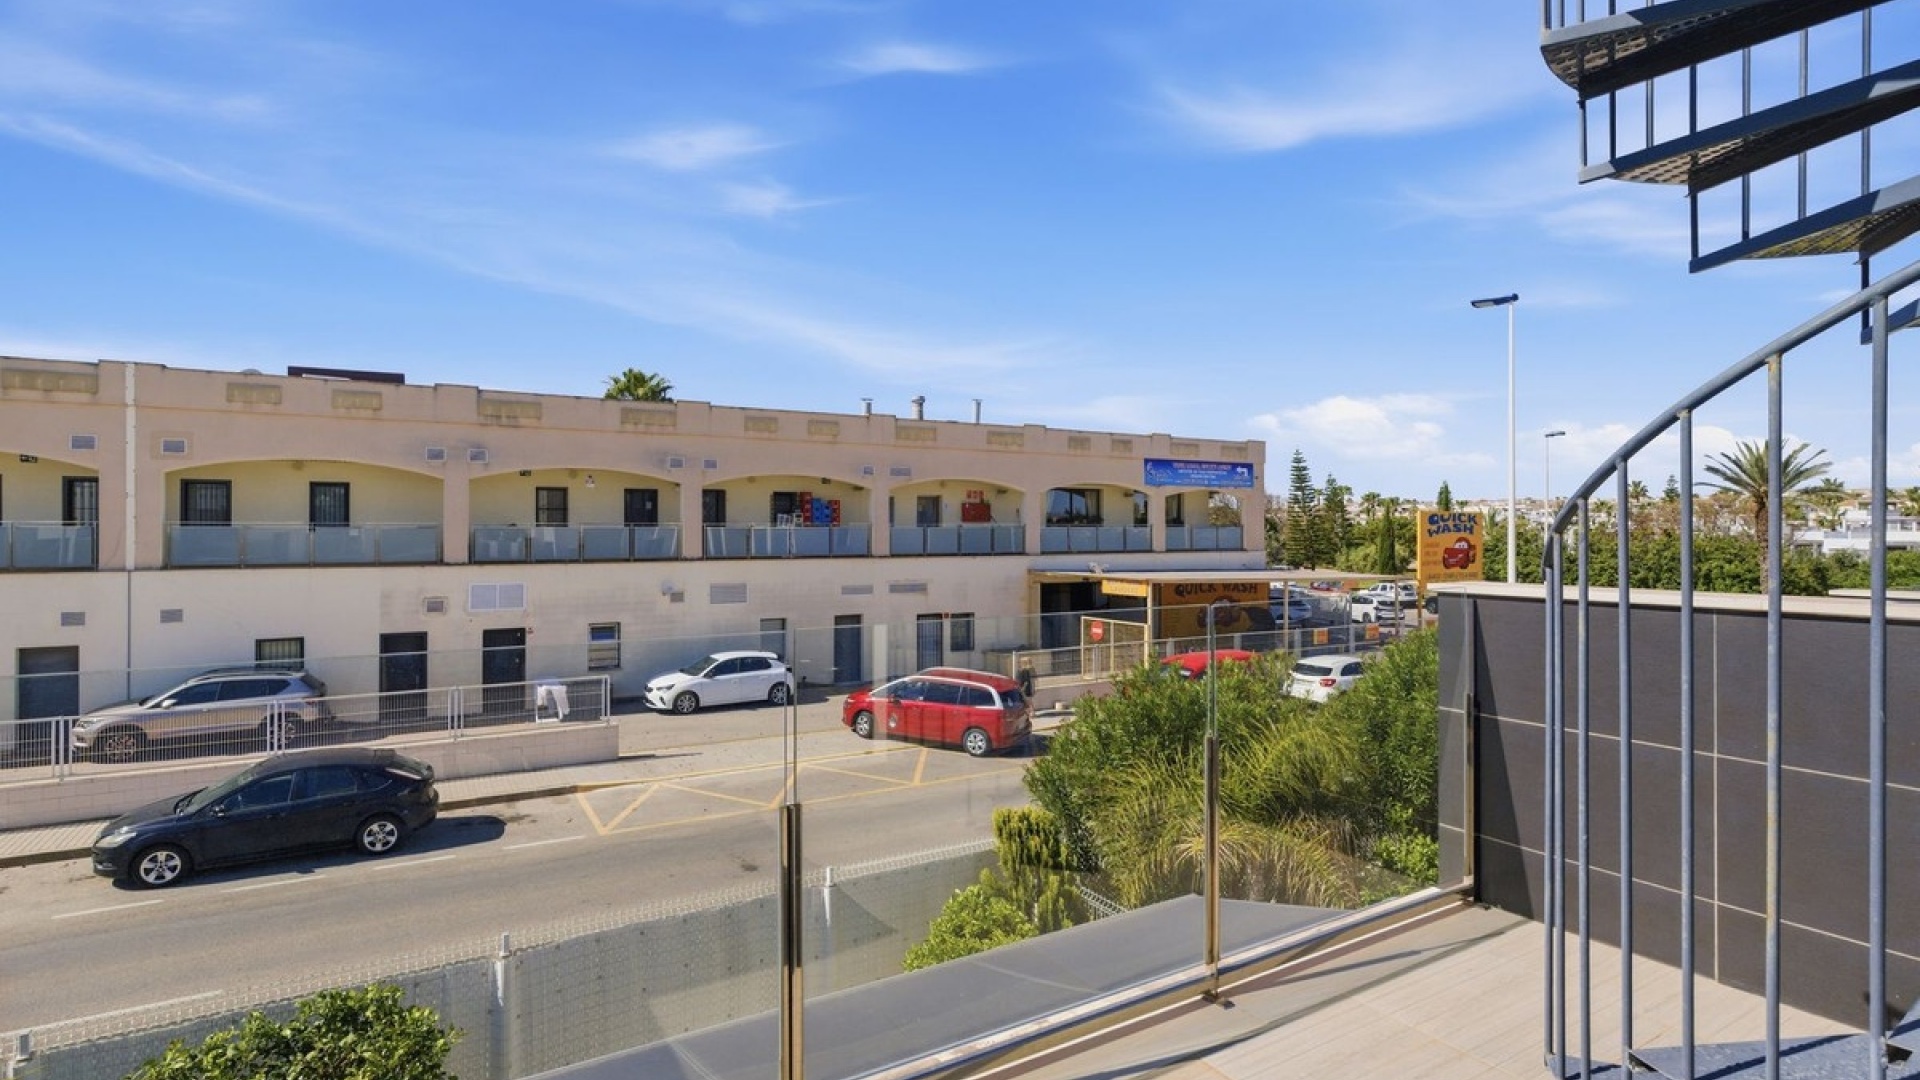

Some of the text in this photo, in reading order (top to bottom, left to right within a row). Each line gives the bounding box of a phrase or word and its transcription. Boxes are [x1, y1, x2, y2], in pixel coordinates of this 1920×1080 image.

[1428, 513, 1477, 525] QUICK
[1427, 524, 1474, 537] WASH
[1174, 582, 1257, 598] QUICK WASH
